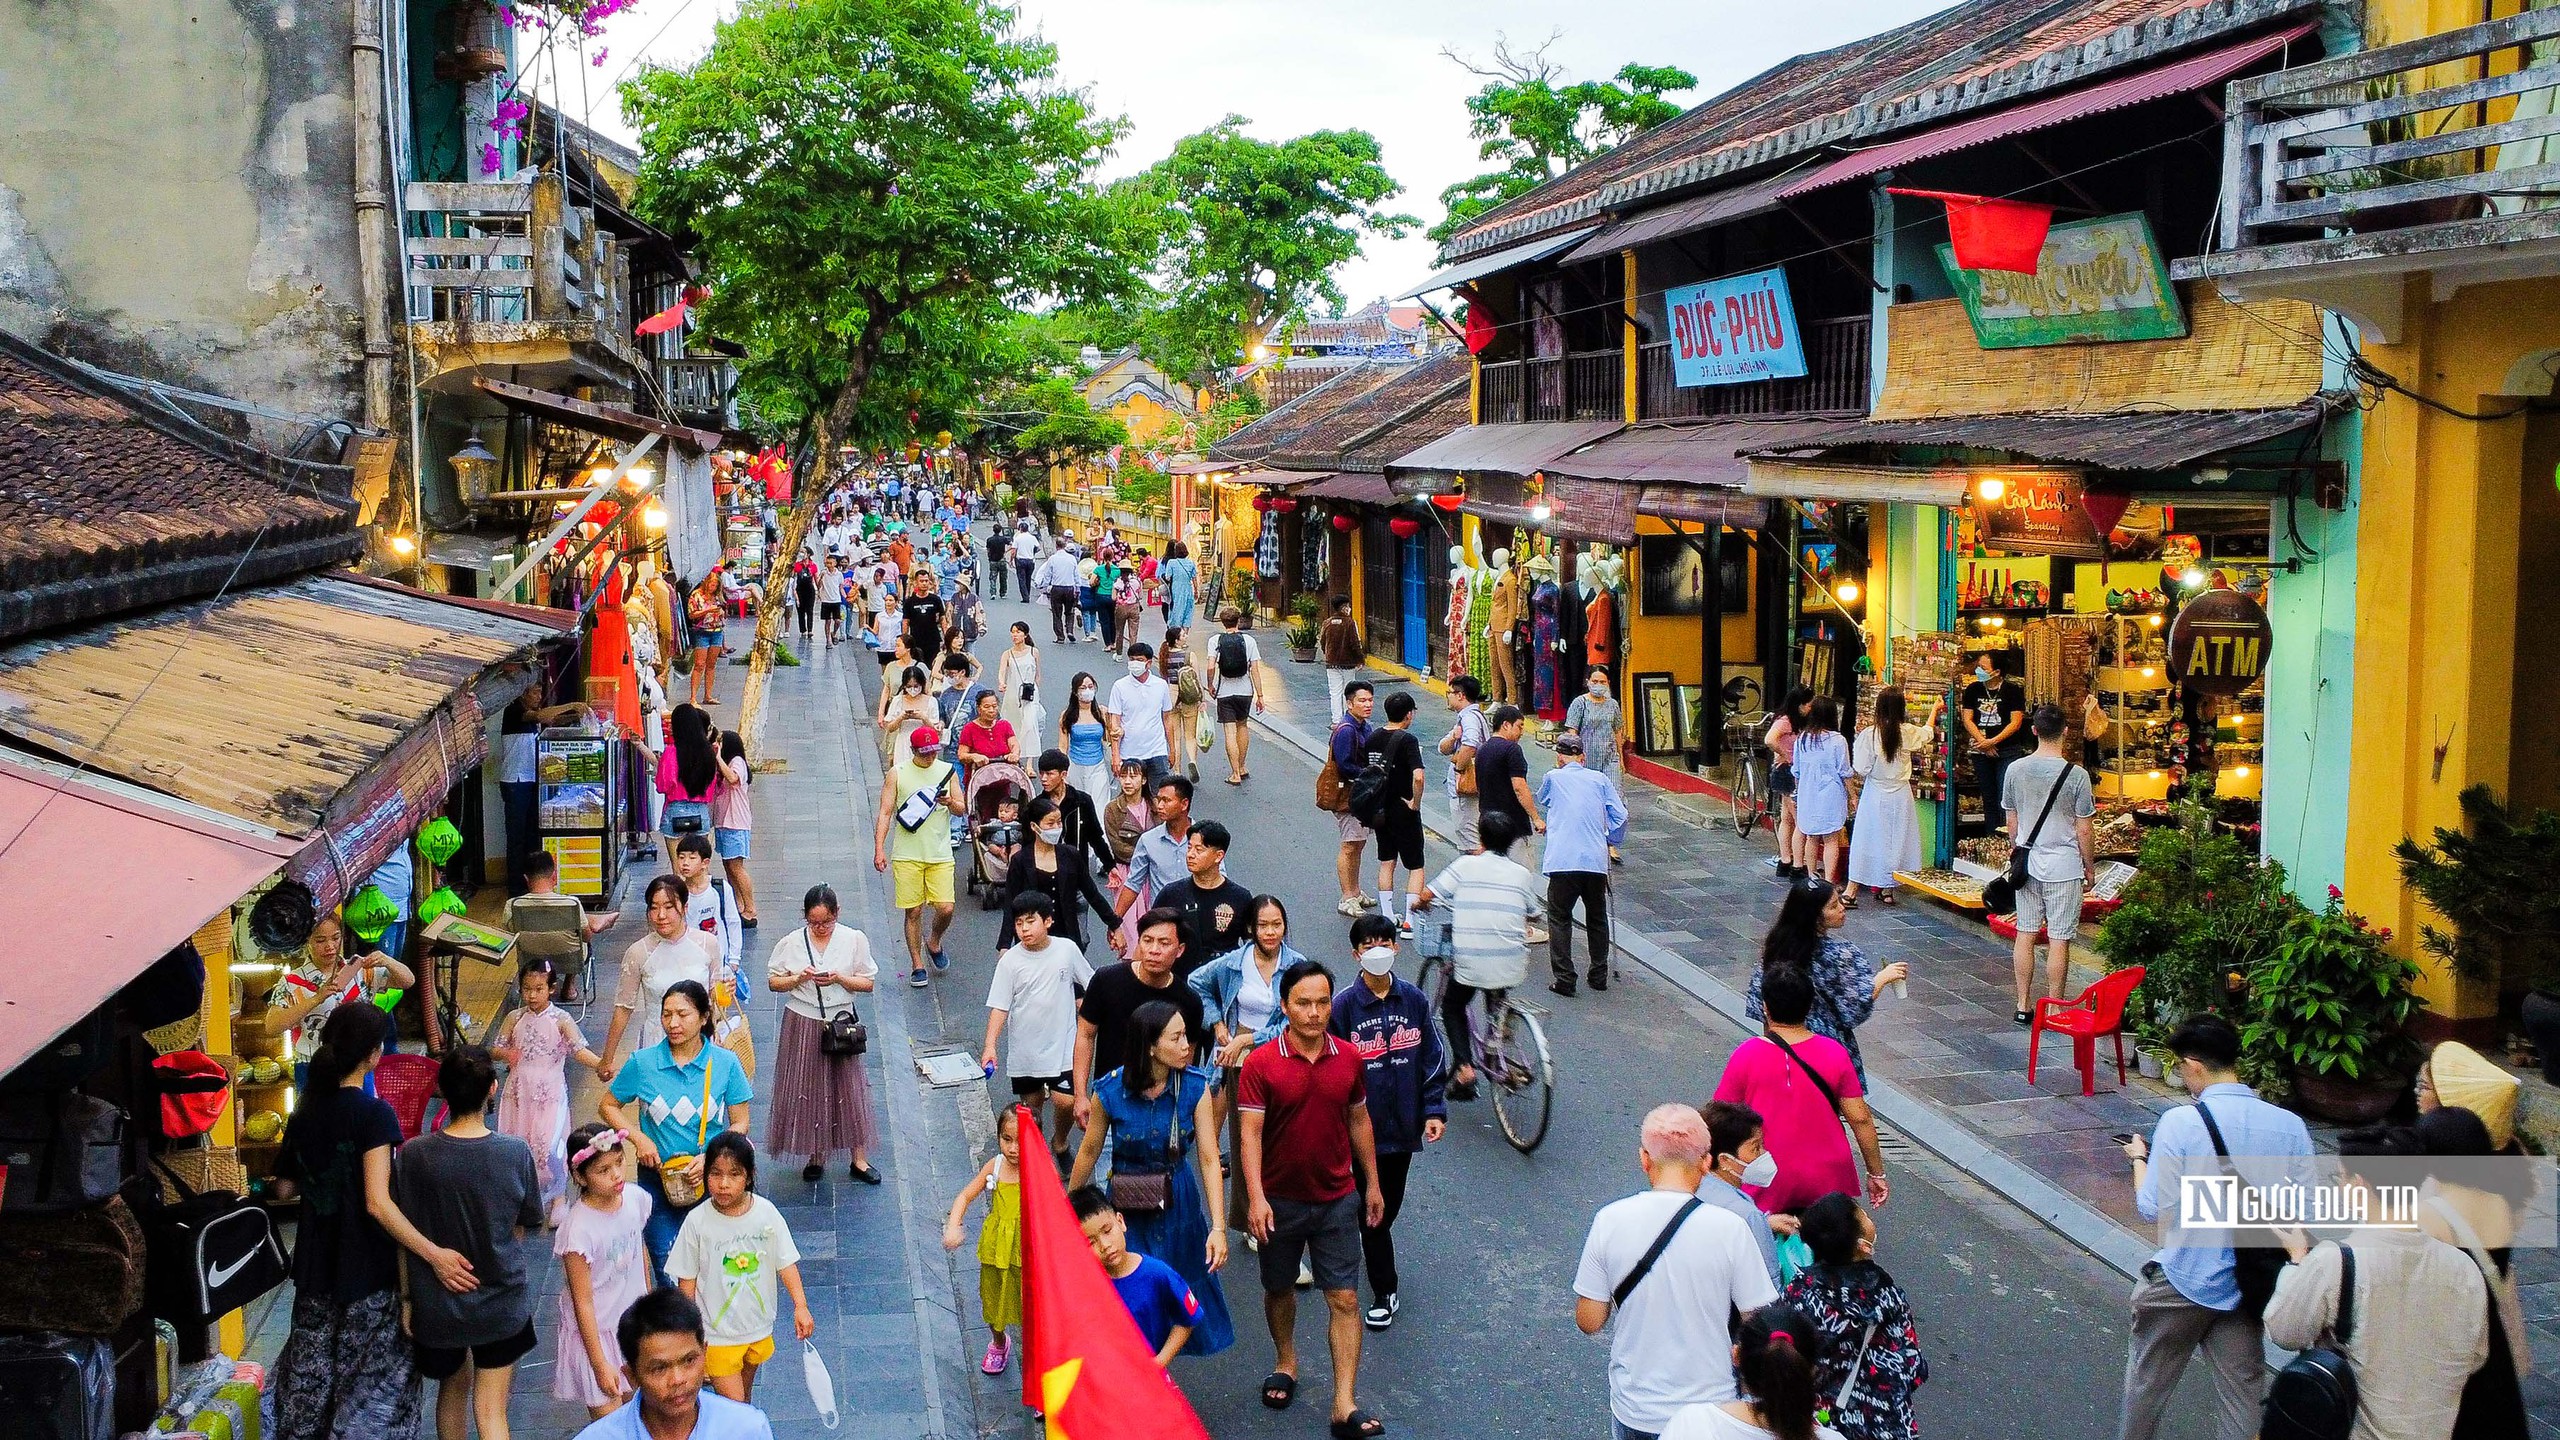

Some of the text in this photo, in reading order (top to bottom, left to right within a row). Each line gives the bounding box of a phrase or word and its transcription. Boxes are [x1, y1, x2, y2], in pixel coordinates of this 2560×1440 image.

[2186, 635, 2260, 677] ATM
[433, 833, 455, 847] MIX
[367, 905, 391, 923] MIX
